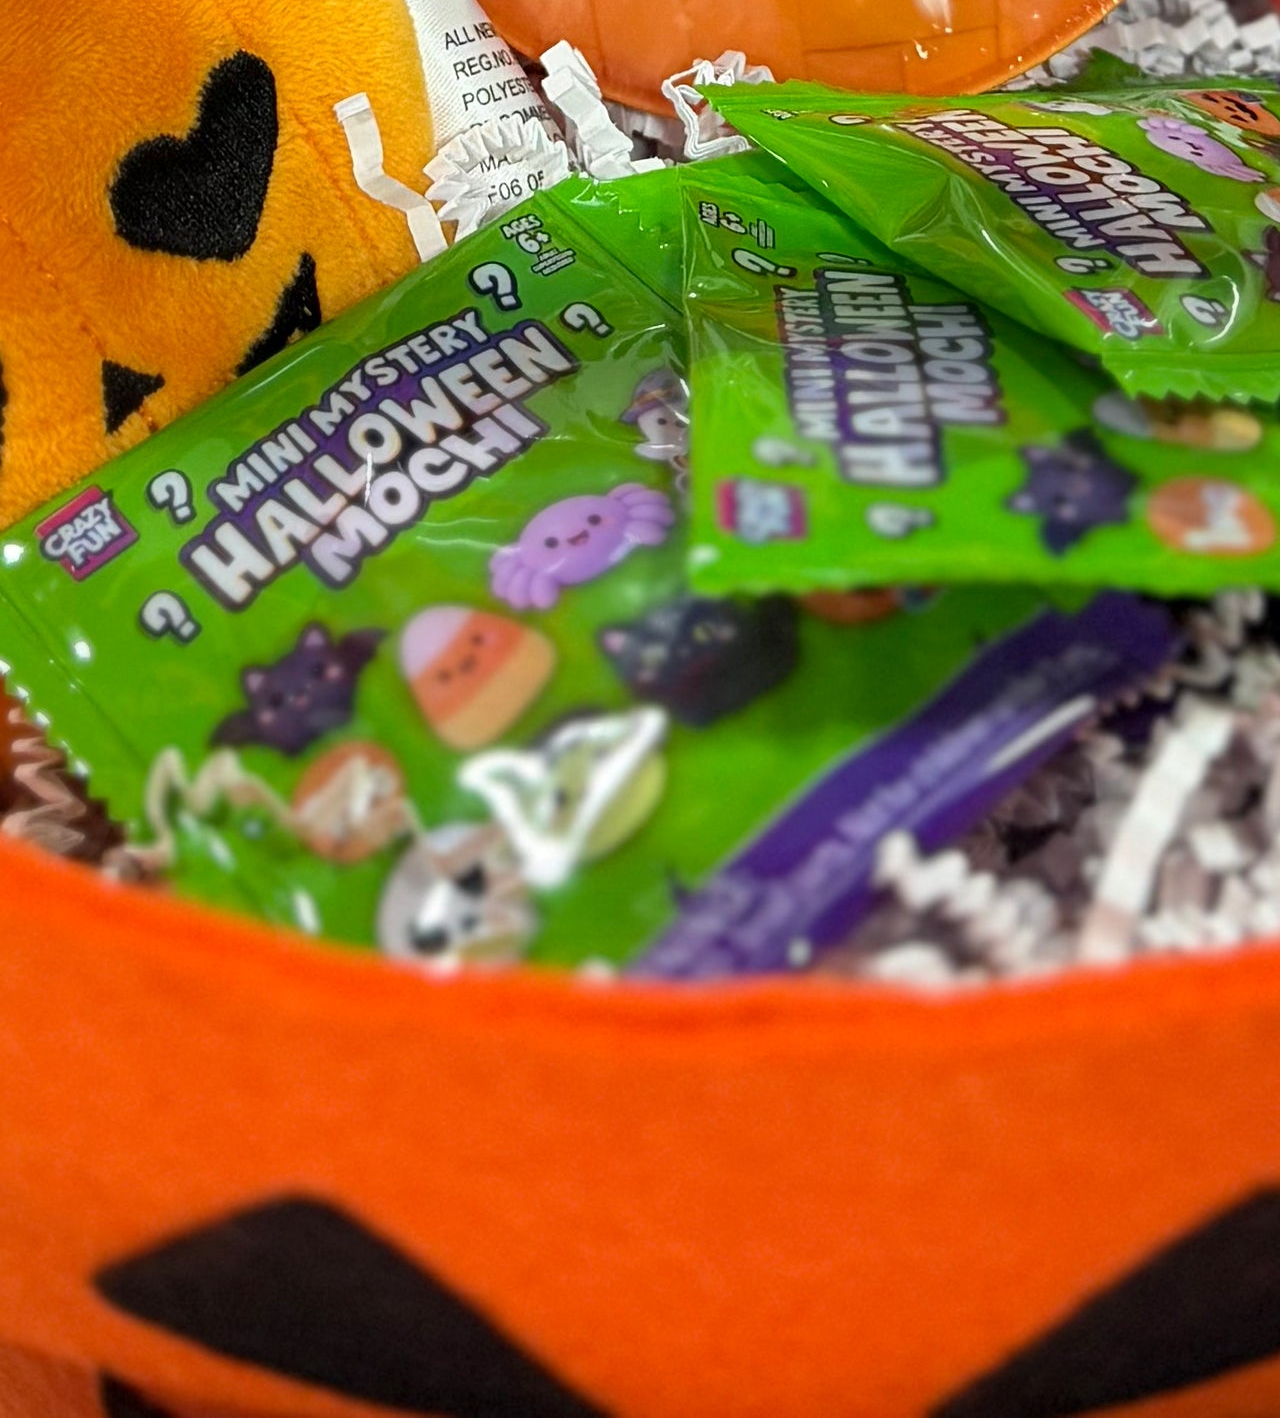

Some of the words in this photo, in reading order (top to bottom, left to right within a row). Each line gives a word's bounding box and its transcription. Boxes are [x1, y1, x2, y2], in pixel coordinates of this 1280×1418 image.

[445, 28, 475, 50] ALL
[897, 120, 1039, 192] MYSTERY
[922, 109, 1203, 274] HALLOWEEN
[1017, 128, 1208, 229] MOCHI
[502, 215, 541, 238] AGES
[517, 232, 549, 254] 6+
[1017, 196, 1106, 248] MINI
[780, 287, 831, 364] MYSTERY
[824, 270, 939, 483] HALLOWEEN
[908, 305, 1000, 424] MOCHI
[216, 423, 317, 513] MINI
[310, 309, 488, 435] MYSTERY
[791, 368, 841, 440] MINI
[191, 326, 573, 604] HALLOWEEN
[311, 402, 544, 582] MOCHI
[44, 498, 113, 557] CRAZY
[68, 516, 123, 565] FUN
